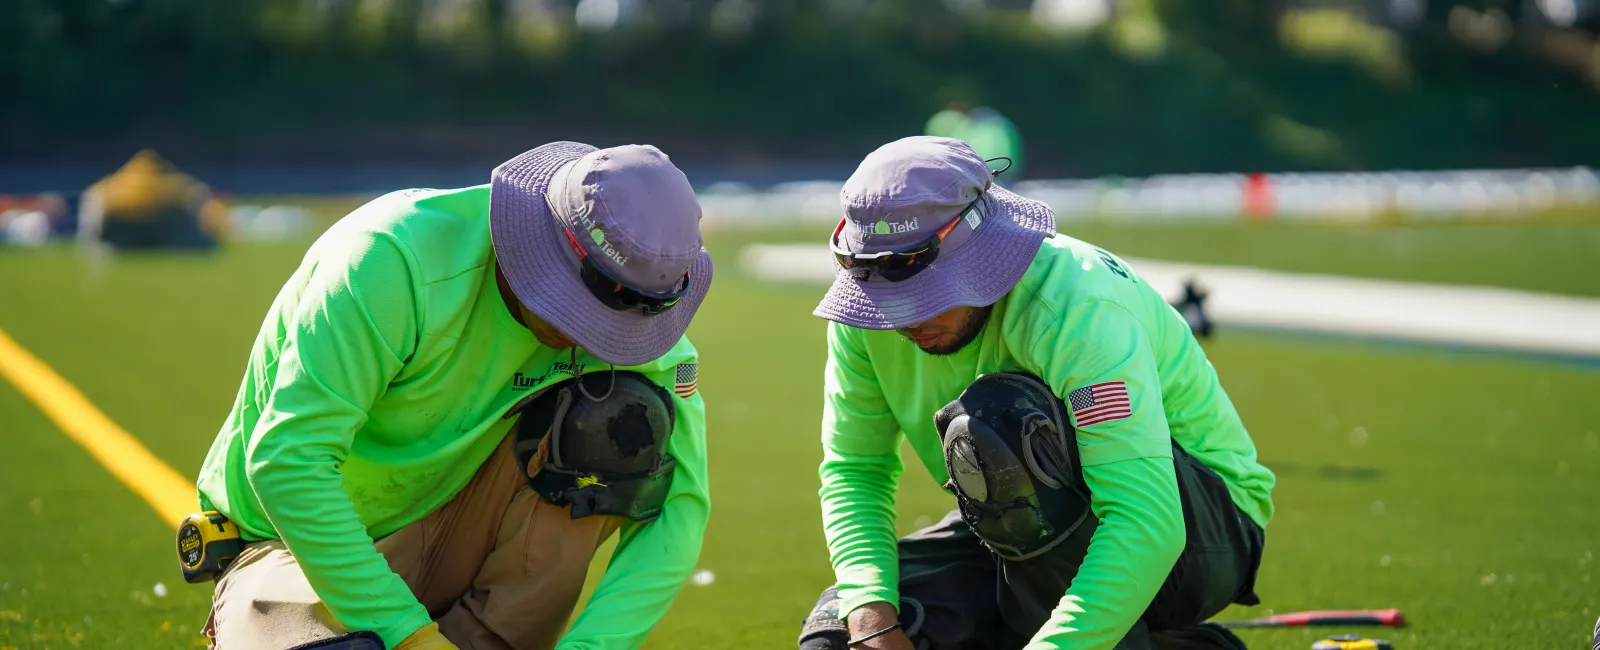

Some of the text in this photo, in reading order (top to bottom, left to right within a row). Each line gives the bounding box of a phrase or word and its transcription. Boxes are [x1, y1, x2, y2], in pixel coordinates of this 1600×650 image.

[889, 216, 920, 234] Teki
[601, 239, 629, 267] Teki
[513, 371, 547, 387] Turf
